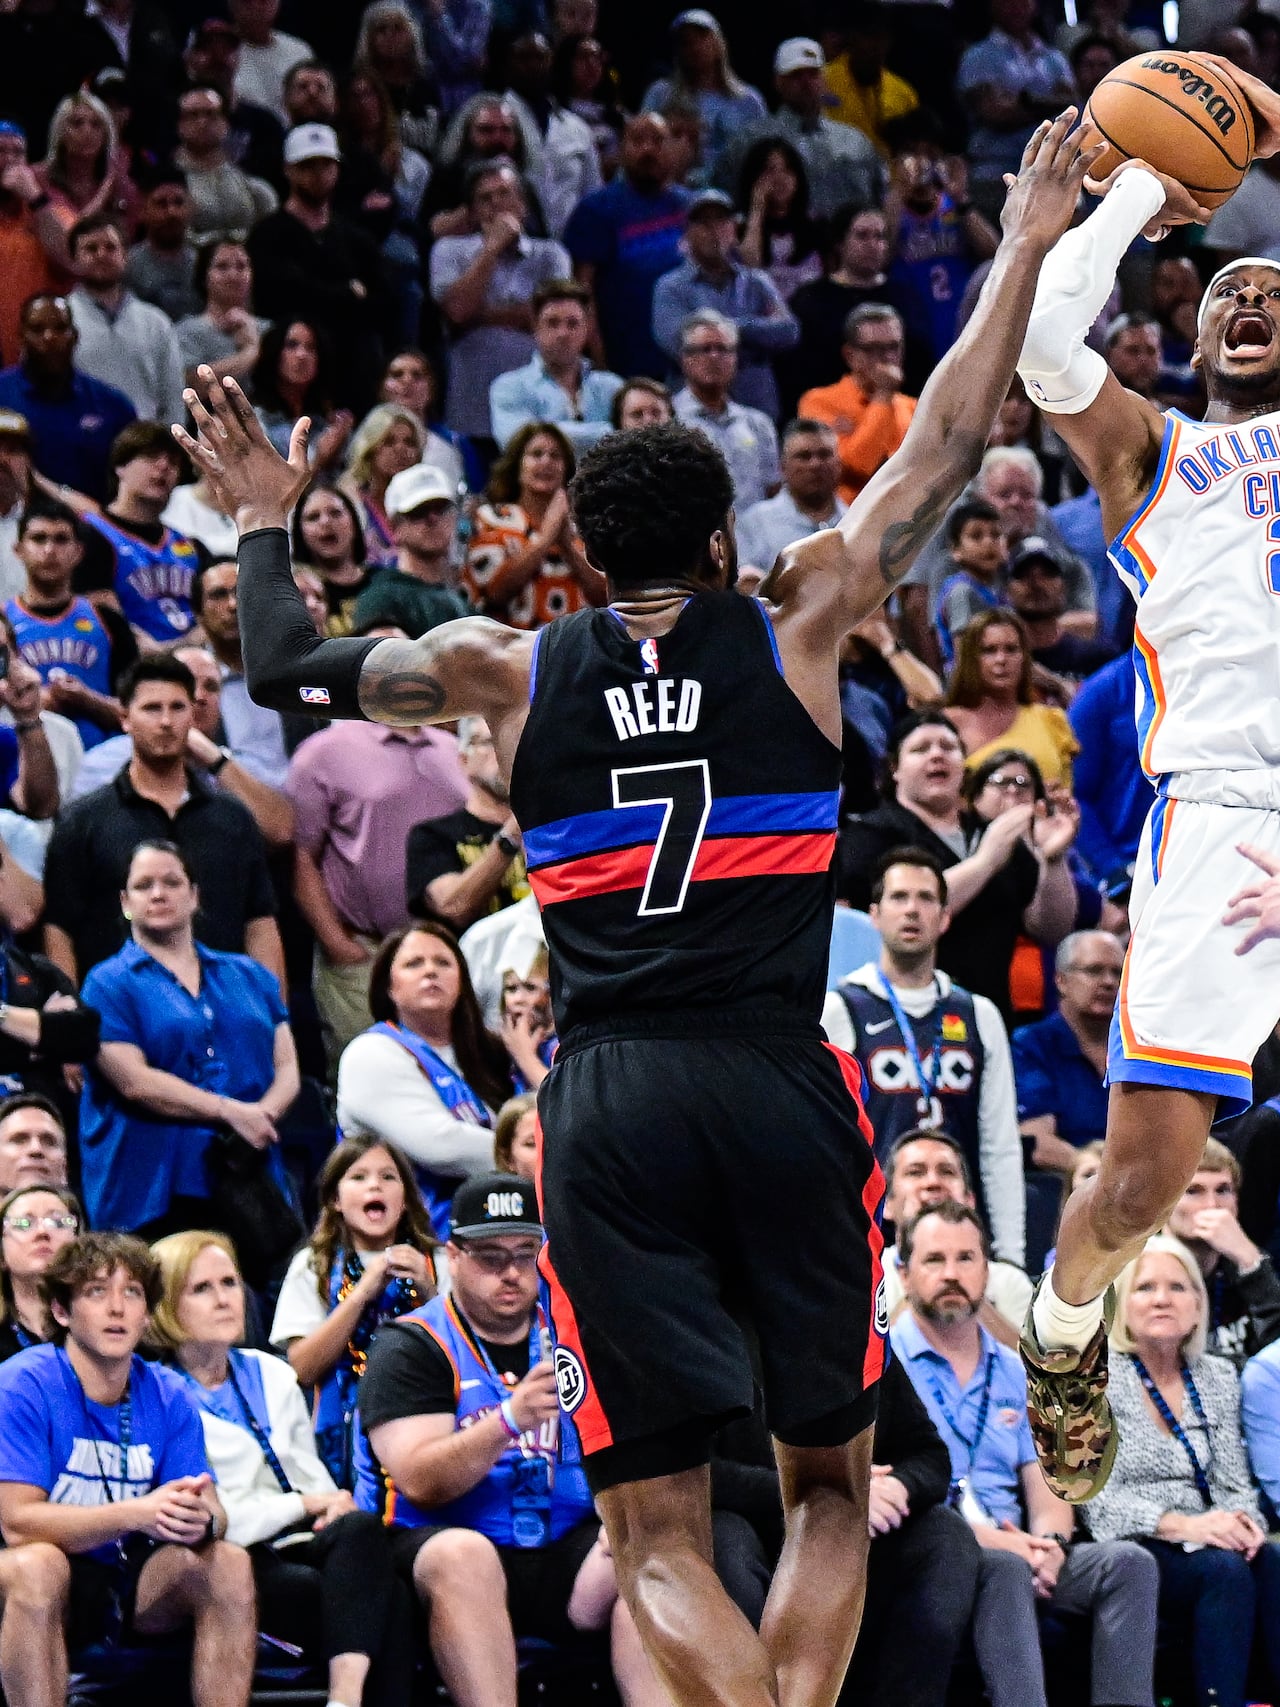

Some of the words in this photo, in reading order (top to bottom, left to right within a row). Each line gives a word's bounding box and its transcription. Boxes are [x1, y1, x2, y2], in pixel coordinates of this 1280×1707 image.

[1141, 58, 1237, 137] Wilson
[603, 678, 703, 741] REED
[611, 758, 713, 917] 7
[487, 1191, 525, 1217] OKC
